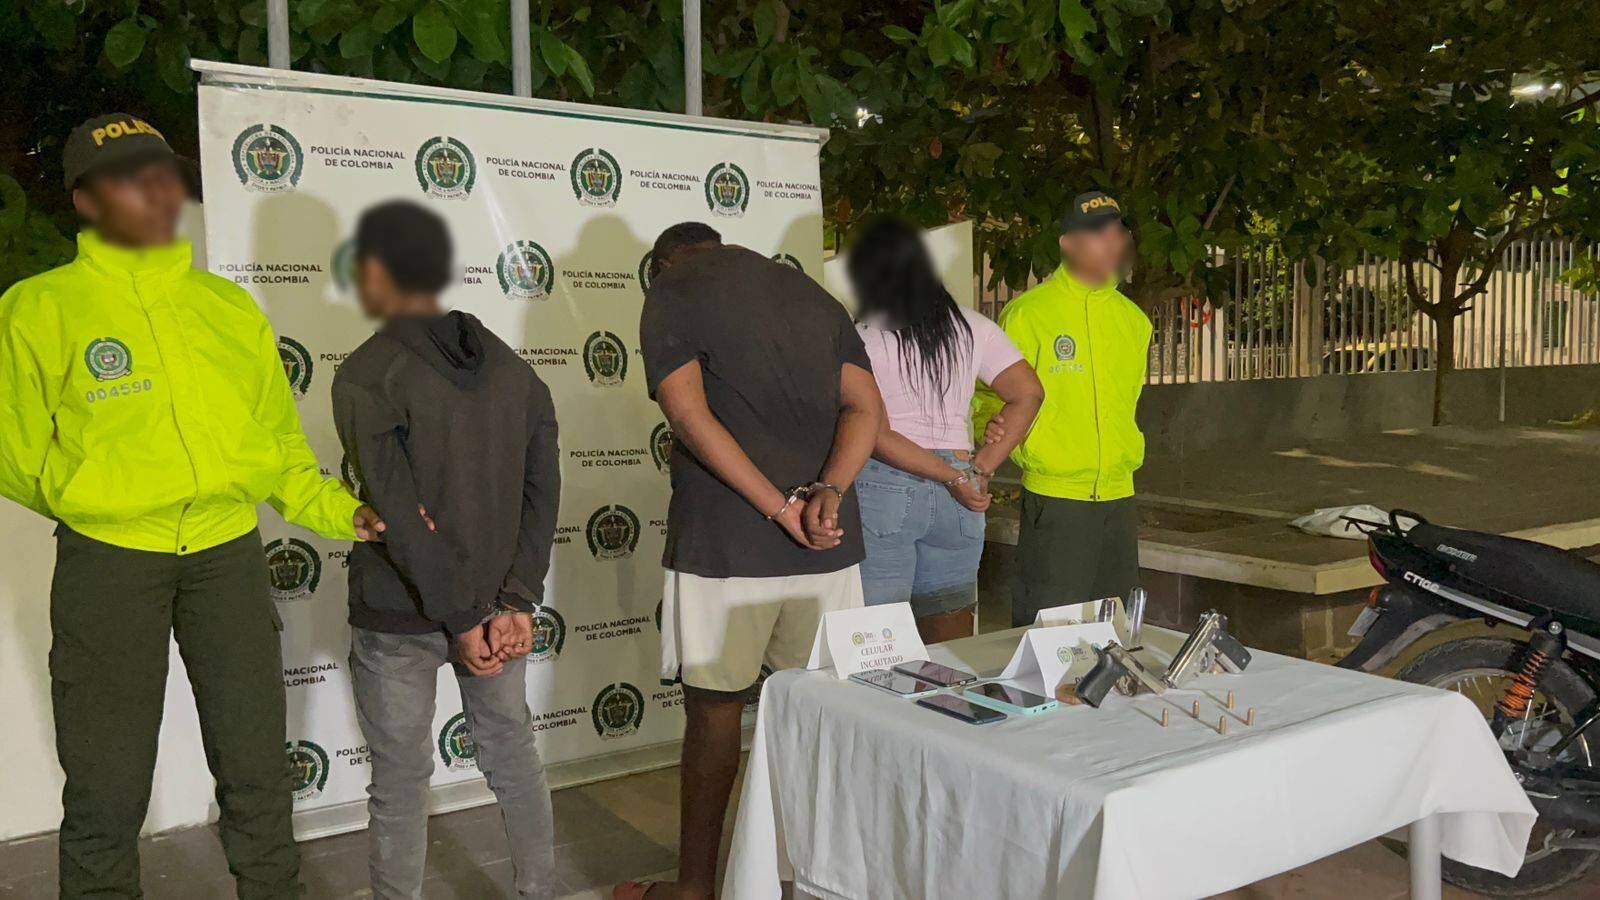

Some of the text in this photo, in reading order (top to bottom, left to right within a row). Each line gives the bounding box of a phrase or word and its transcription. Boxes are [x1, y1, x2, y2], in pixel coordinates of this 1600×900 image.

[353, 149, 406, 160] NACIONAL
[324, 158, 393, 170] DE COLOMBIA
[521, 160, 566, 172] NACIONAL
[498, 168, 555, 181] DE COLOMBIA
[661, 172, 701, 183] NACIONAL
[640, 181, 691, 192] DE COLOMBIA
[784, 182, 819, 192] NACIONAL
[764, 190, 811, 200] DE COLOMBIA
[266, 264, 322, 272] NACIONAL
[465, 266, 493, 274] IONAL
[235, 275, 310, 284] DE COLOMBIA
[594, 271, 636, 280] NACIONAL
[573, 281, 626, 290] DE COLOMBIA
[530, 348, 579, 356] NACIONAL
[607, 448, 648, 457] NACIONAL
[582, 458, 641, 467] DE COLOMBIA
[610, 616, 651, 628] NACIONAL
[586, 627, 641, 641] DE COLOMBIA
[861, 644, 894, 656] CELULAR
[860, 655, 904, 670] INCAUTADO
[284, 662, 339, 676] NACIONAL
[662, 700, 672, 708] DE
[543, 706, 587, 720] NACIONAL
[532, 718, 577, 732] COLOMBIA
[350, 757, 362, 766] DE
